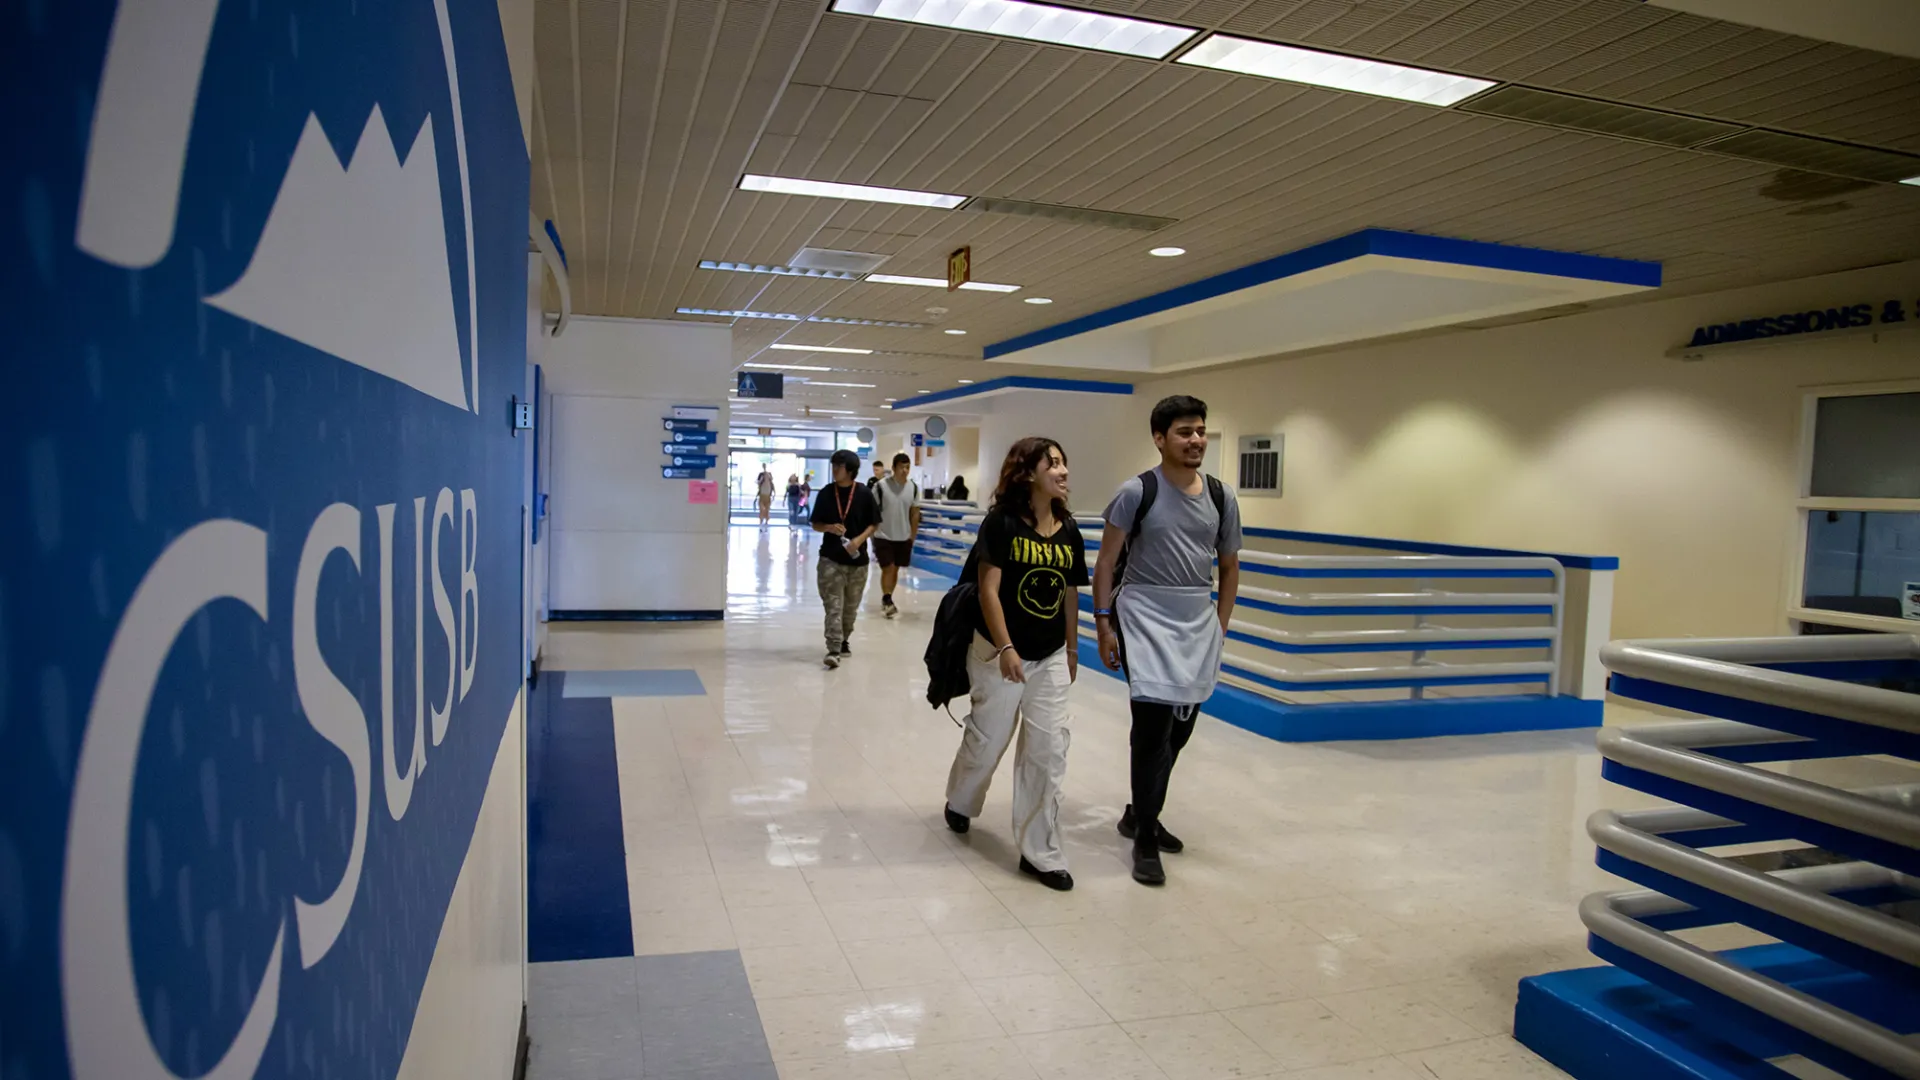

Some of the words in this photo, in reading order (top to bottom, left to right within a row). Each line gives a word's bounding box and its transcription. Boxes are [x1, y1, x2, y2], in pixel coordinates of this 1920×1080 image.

[1686, 304, 1873, 347] ADMISSIONS
[1880, 300, 1905, 323] &
[1009, 536, 1074, 570] NIRVAN
[60, 486, 479, 1080] CSUSB
